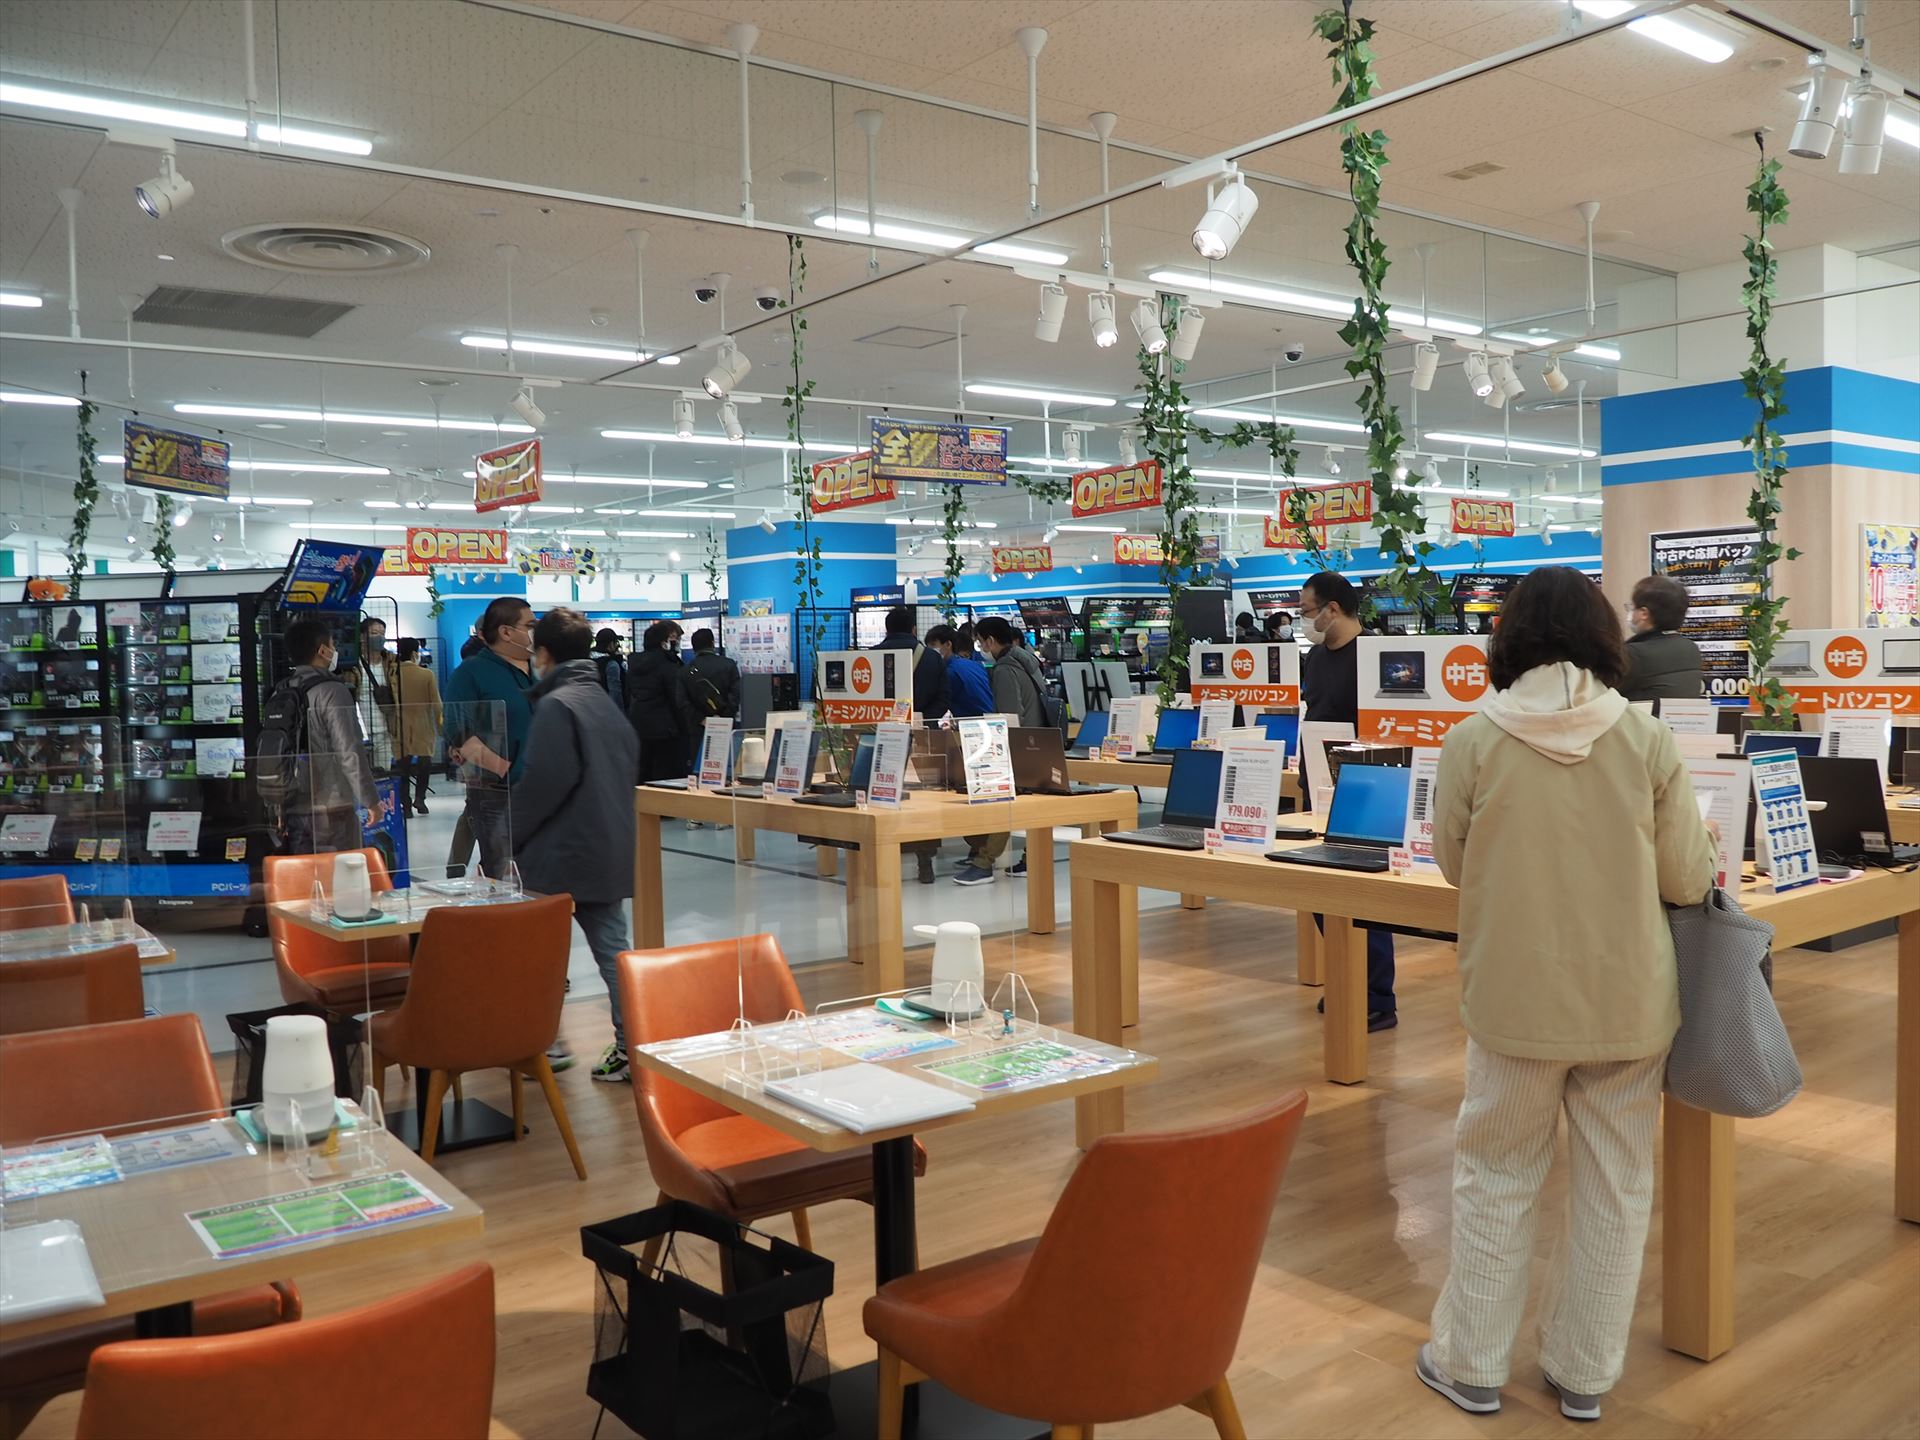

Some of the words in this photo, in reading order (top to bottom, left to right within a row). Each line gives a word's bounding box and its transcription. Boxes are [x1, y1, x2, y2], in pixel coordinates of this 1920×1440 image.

[478, 449, 536, 504] OPEN
[816, 458, 887, 506] OPEN
[1075, 466, 1156, 511] OPEN
[1456, 501, 1512, 532] OPEN
[1268, 520, 1325, 546] ON
[412, 531, 502, 559] OPEN
[1117, 538, 1171, 561] OPE
[1656, 544, 1752, 562] 中古PC応援パック
[996, 549, 1050, 571] OPEN
[1734, 557, 1757, 566] Gam
[1233, 658, 1253, 672] 中古
[1828, 649, 1864, 667] 中古
[853, 668, 870, 684] 中古
[1445, 662, 1488, 686] 中古
[1200, 688, 1289, 702] ゲーミングパソコン
[825, 704, 893, 720] ゲーミングパソコ
[1377, 717, 1455, 740] ゲーミン
[1420, 822, 1433, 835] ¥9
[211, 883, 247, 891] PCパーツ
